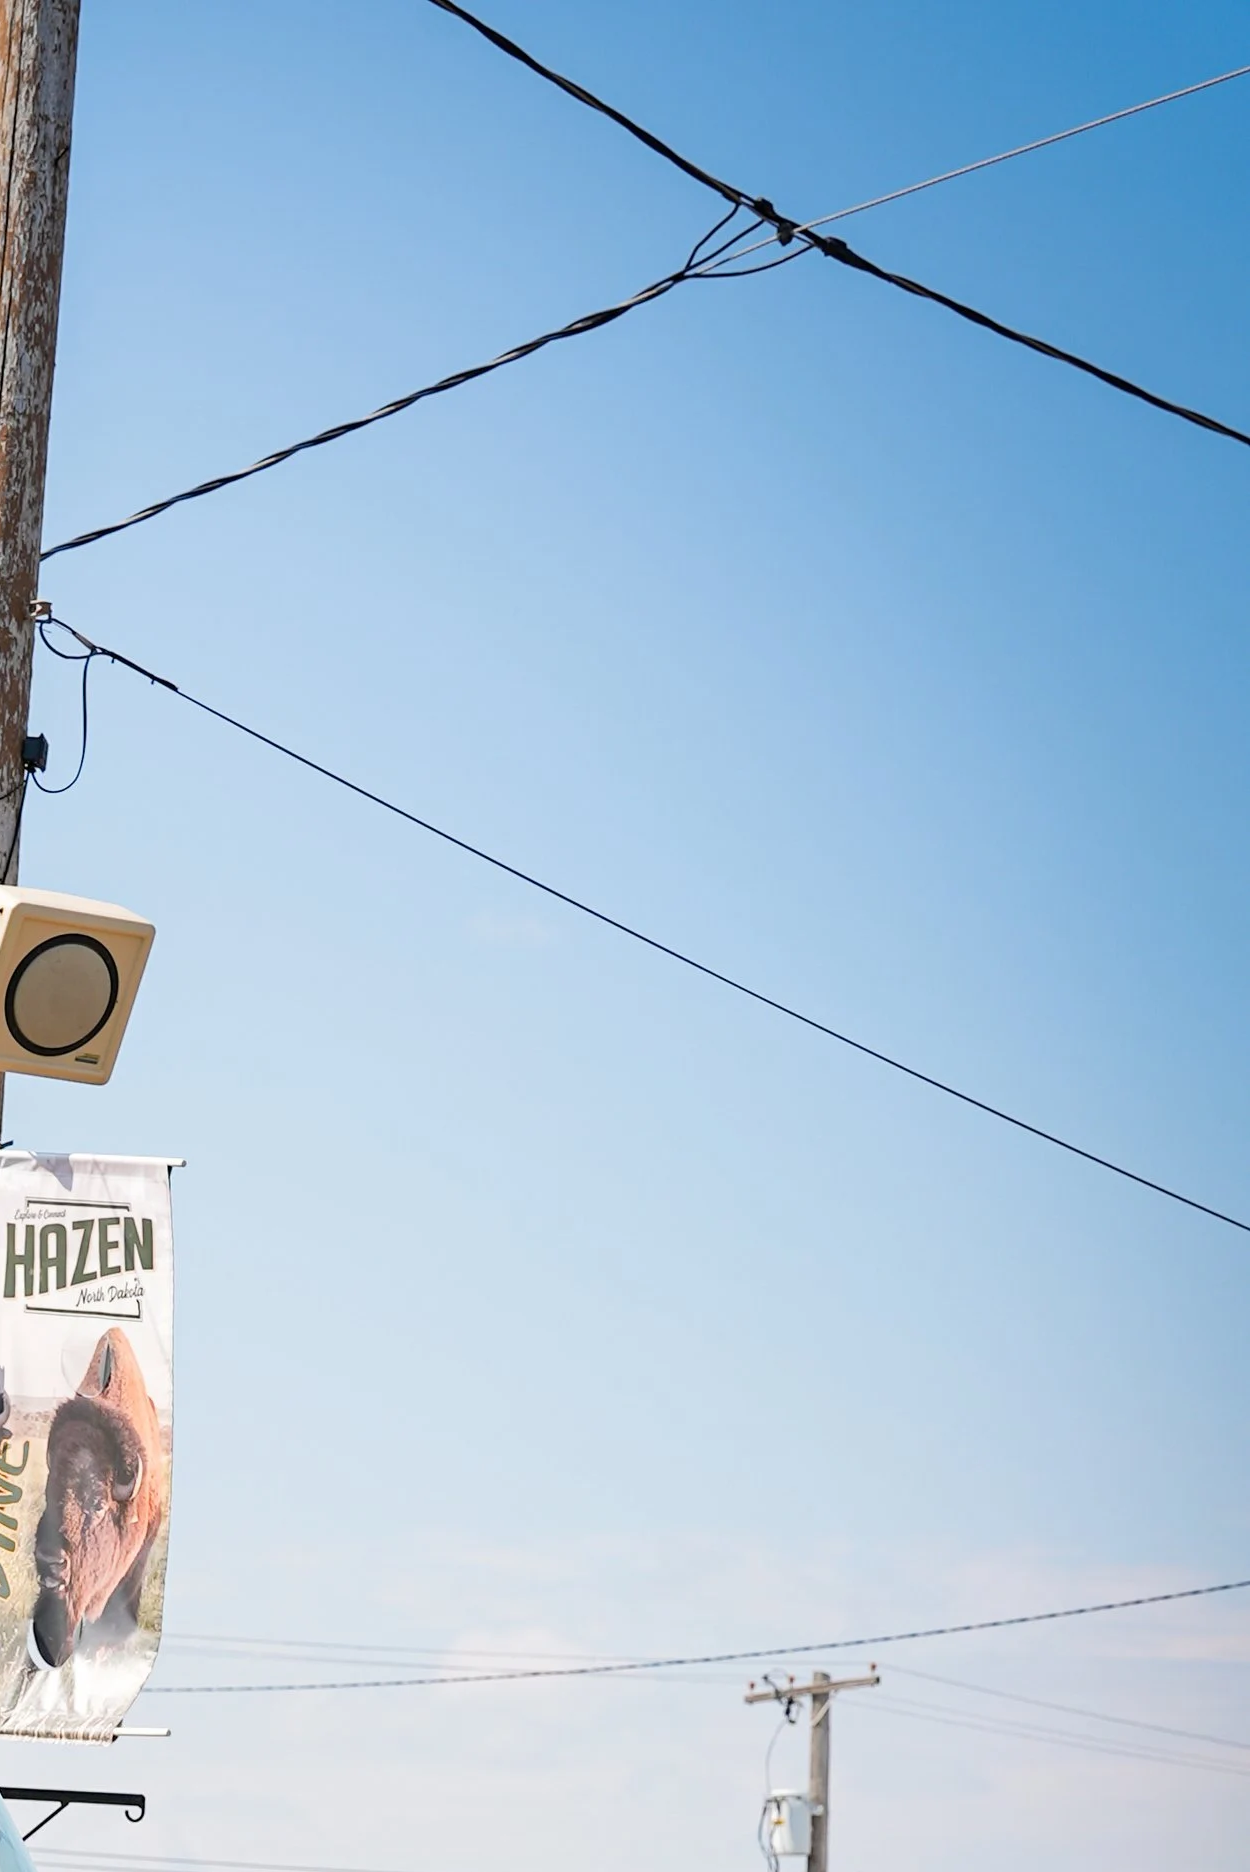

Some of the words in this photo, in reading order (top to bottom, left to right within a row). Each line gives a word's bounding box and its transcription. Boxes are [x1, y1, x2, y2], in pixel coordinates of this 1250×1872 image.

[3, 1216, 154, 1298] HAZEN
[76, 1289, 105, 1307] North
[107, 1279, 144, 1303] Dakota
